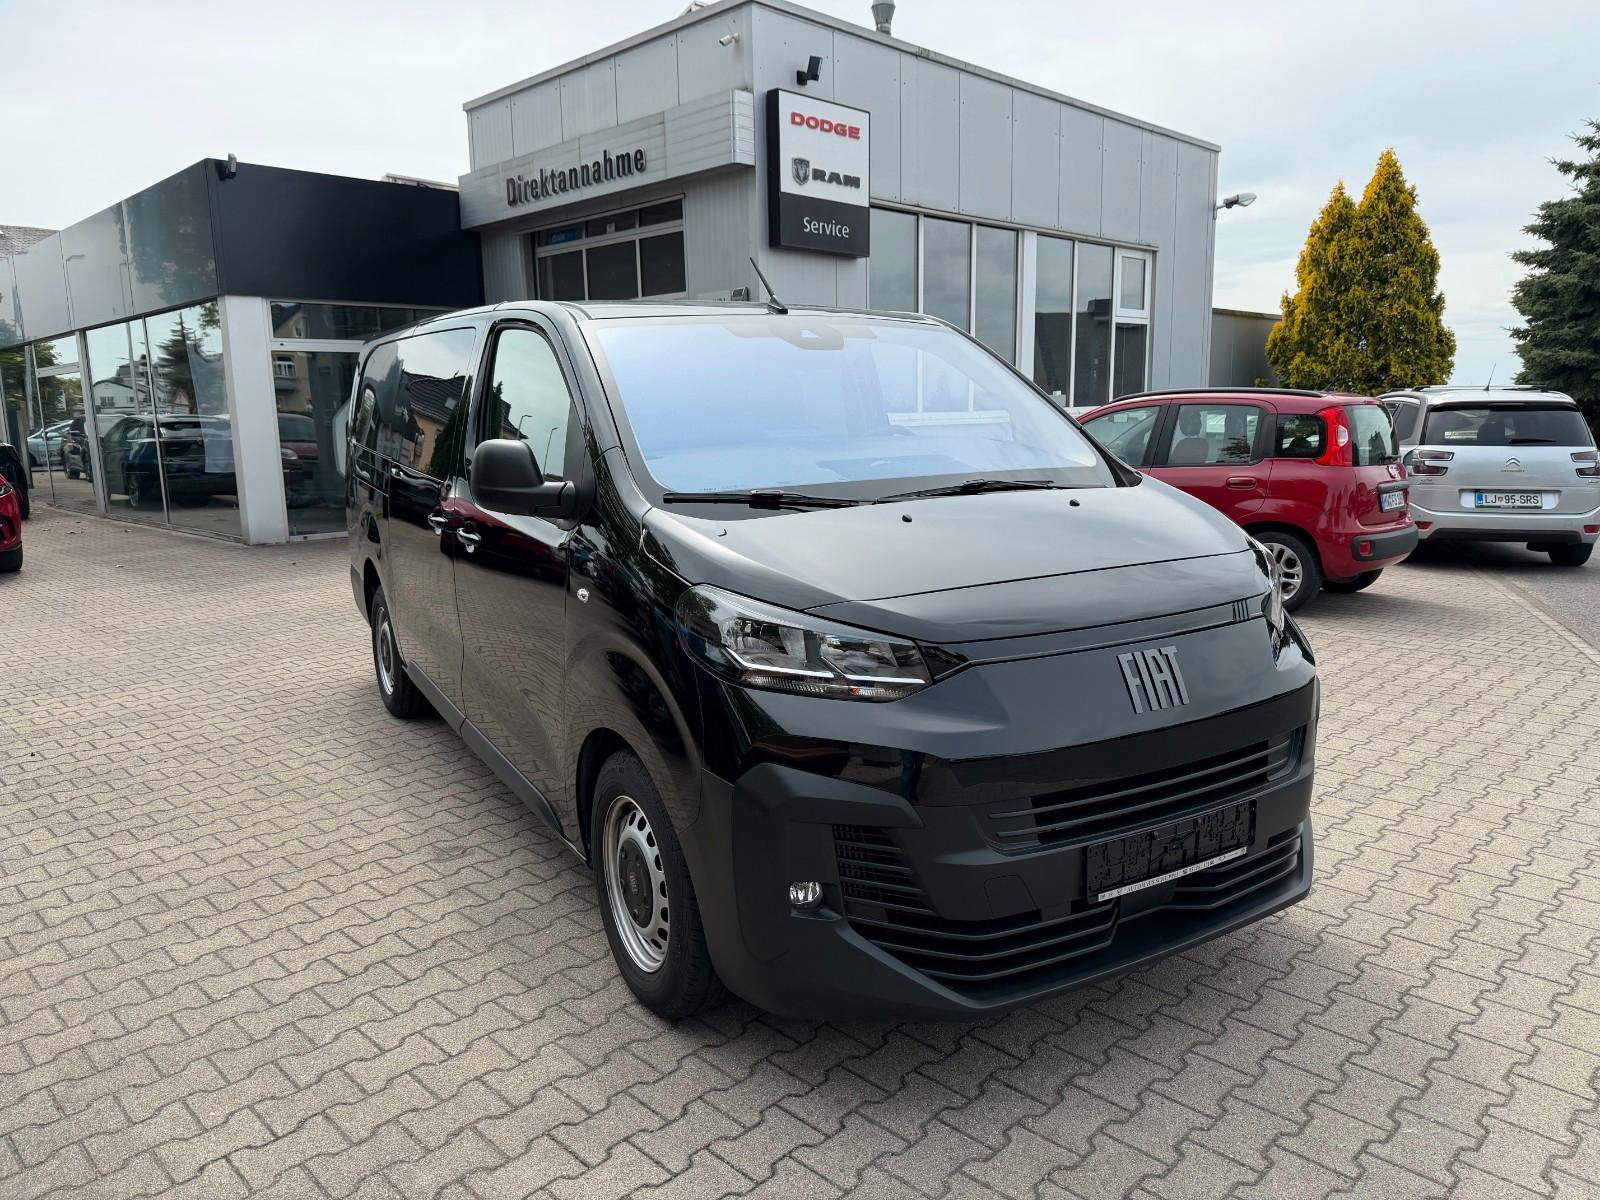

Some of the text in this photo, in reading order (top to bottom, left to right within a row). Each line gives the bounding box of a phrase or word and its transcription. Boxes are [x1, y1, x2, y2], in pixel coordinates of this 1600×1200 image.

[790, 111, 860, 140] DODGE
[506, 148, 646, 207] Direktannahme
[812, 168, 861, 189] RAM
[803, 216, 850, 238] Service
[1117, 645, 1190, 715] FIAT
